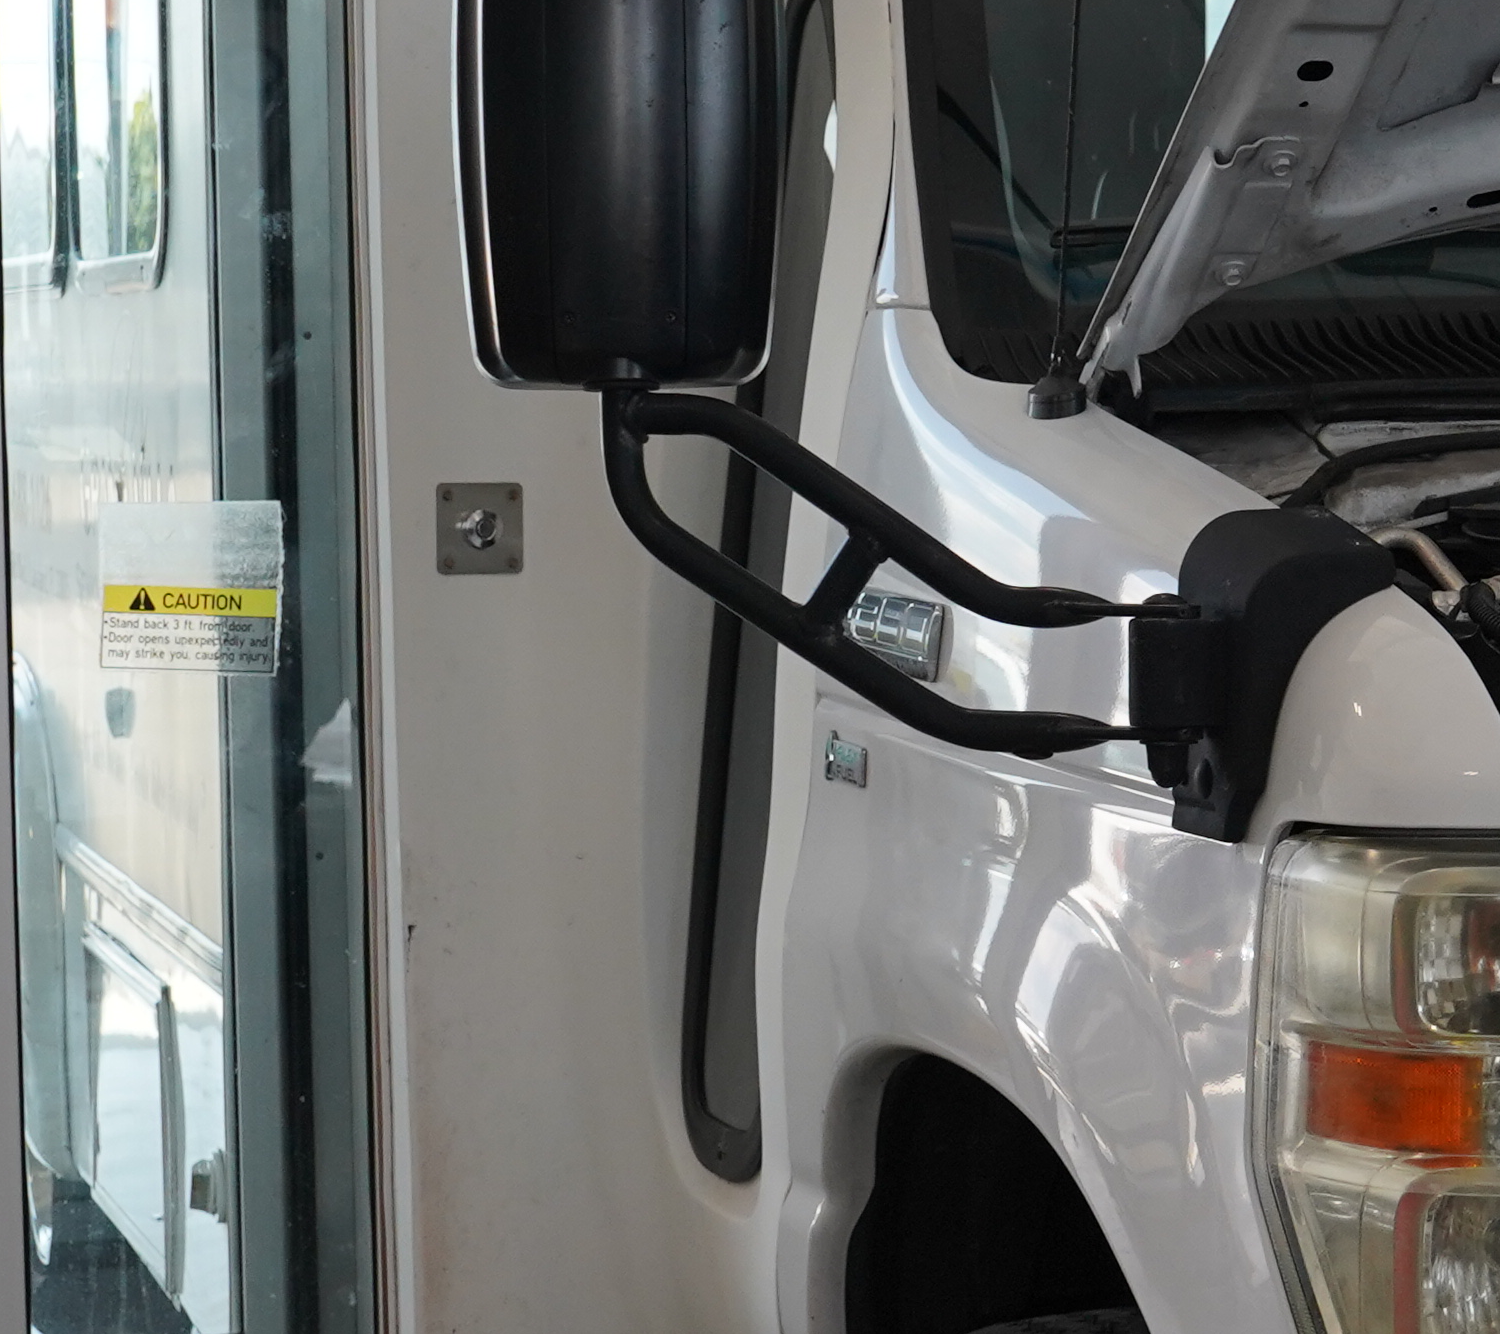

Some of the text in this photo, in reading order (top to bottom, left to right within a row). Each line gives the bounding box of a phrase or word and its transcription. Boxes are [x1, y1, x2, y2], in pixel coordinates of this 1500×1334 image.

[162, 592, 243, 611] CAUTION
[108, 617, 140, 629] Stand
[144, 618, 170, 630] back
[173, 619, 180, 630] 3
[199, 620, 225, 632] from
[107, 631, 133, 644] Door
[138, 635, 170, 647] opens
[249, 636, 269, 648] and
[107, 648, 131, 660] may
[135, 648, 165, 659] strike
